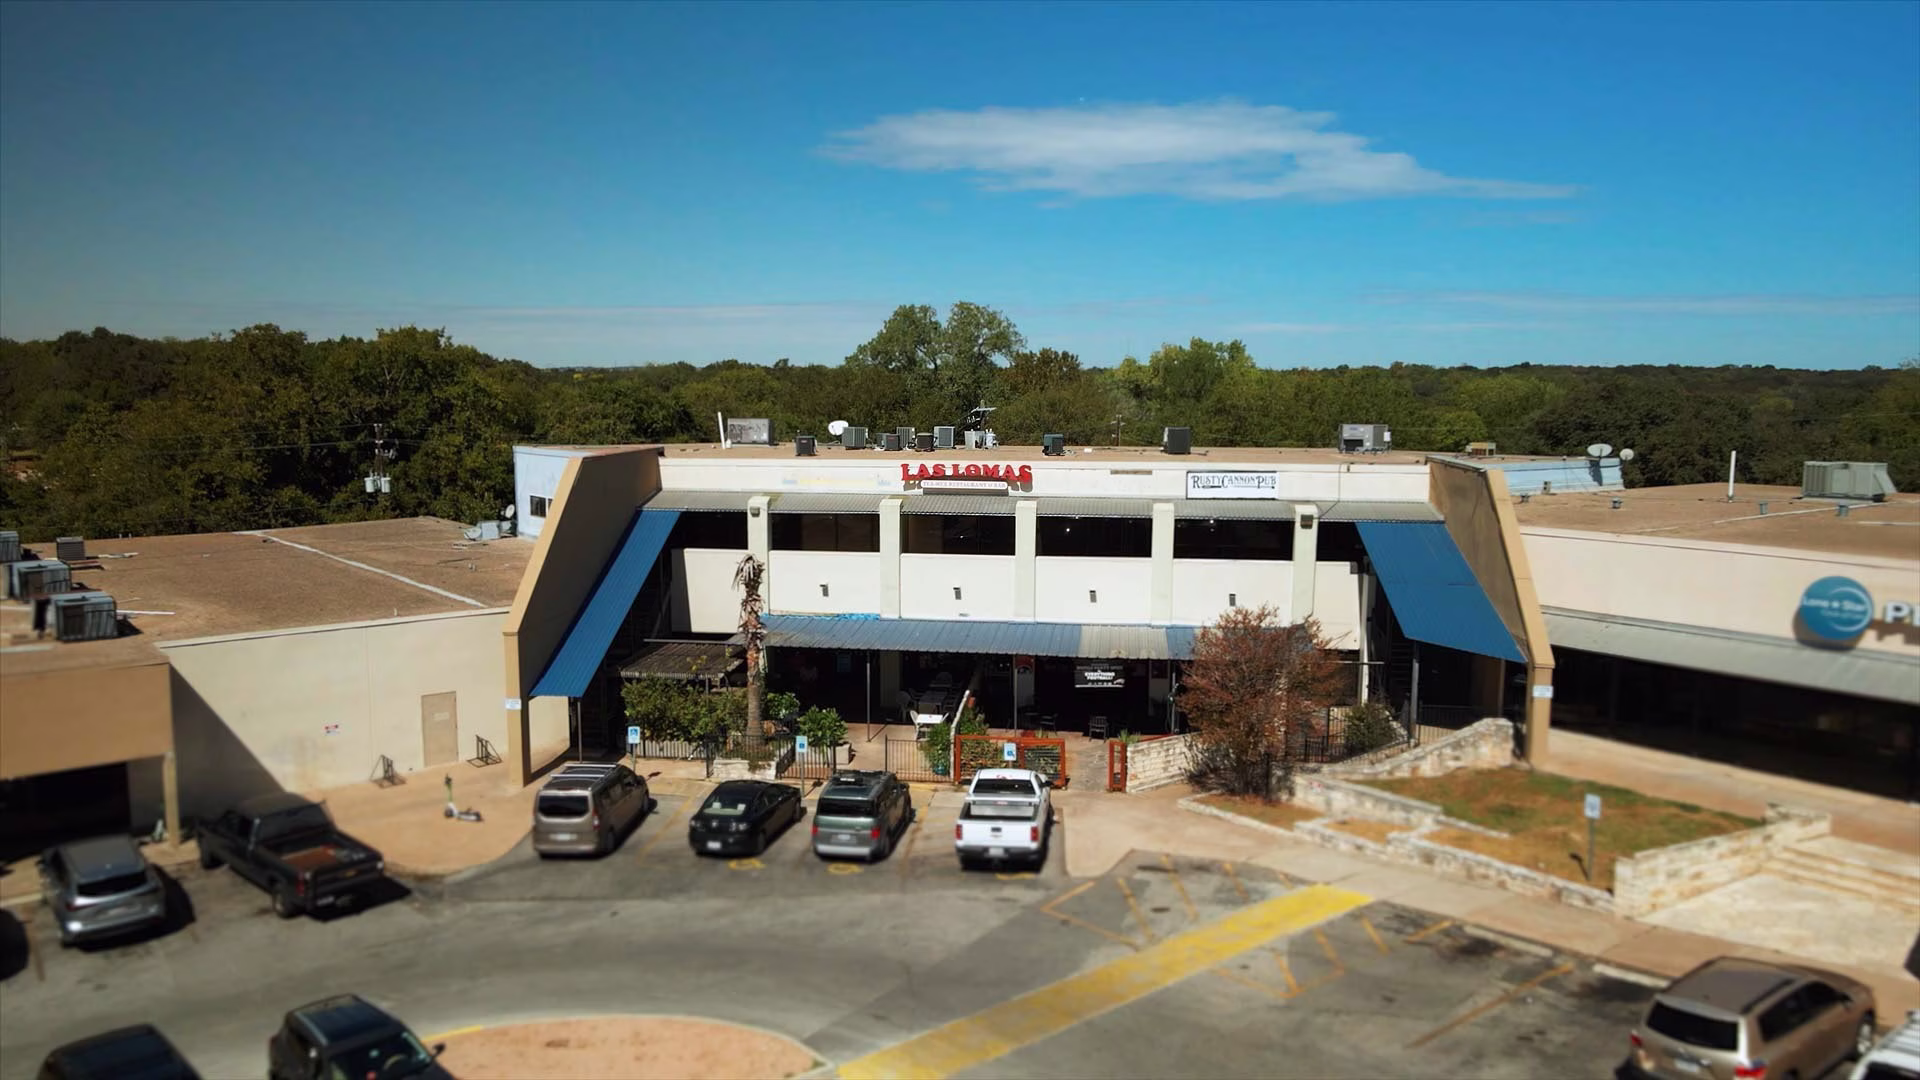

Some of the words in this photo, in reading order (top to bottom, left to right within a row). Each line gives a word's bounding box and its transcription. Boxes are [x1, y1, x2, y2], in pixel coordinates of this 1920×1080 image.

[901, 463, 946, 481] LAS
[951, 464, 1032, 483] LOMAS
[1191, 475, 1222, 489] RUSTY
[1221, 475, 1256, 489] CANNON
[1255, 475, 1277, 489] PUB
